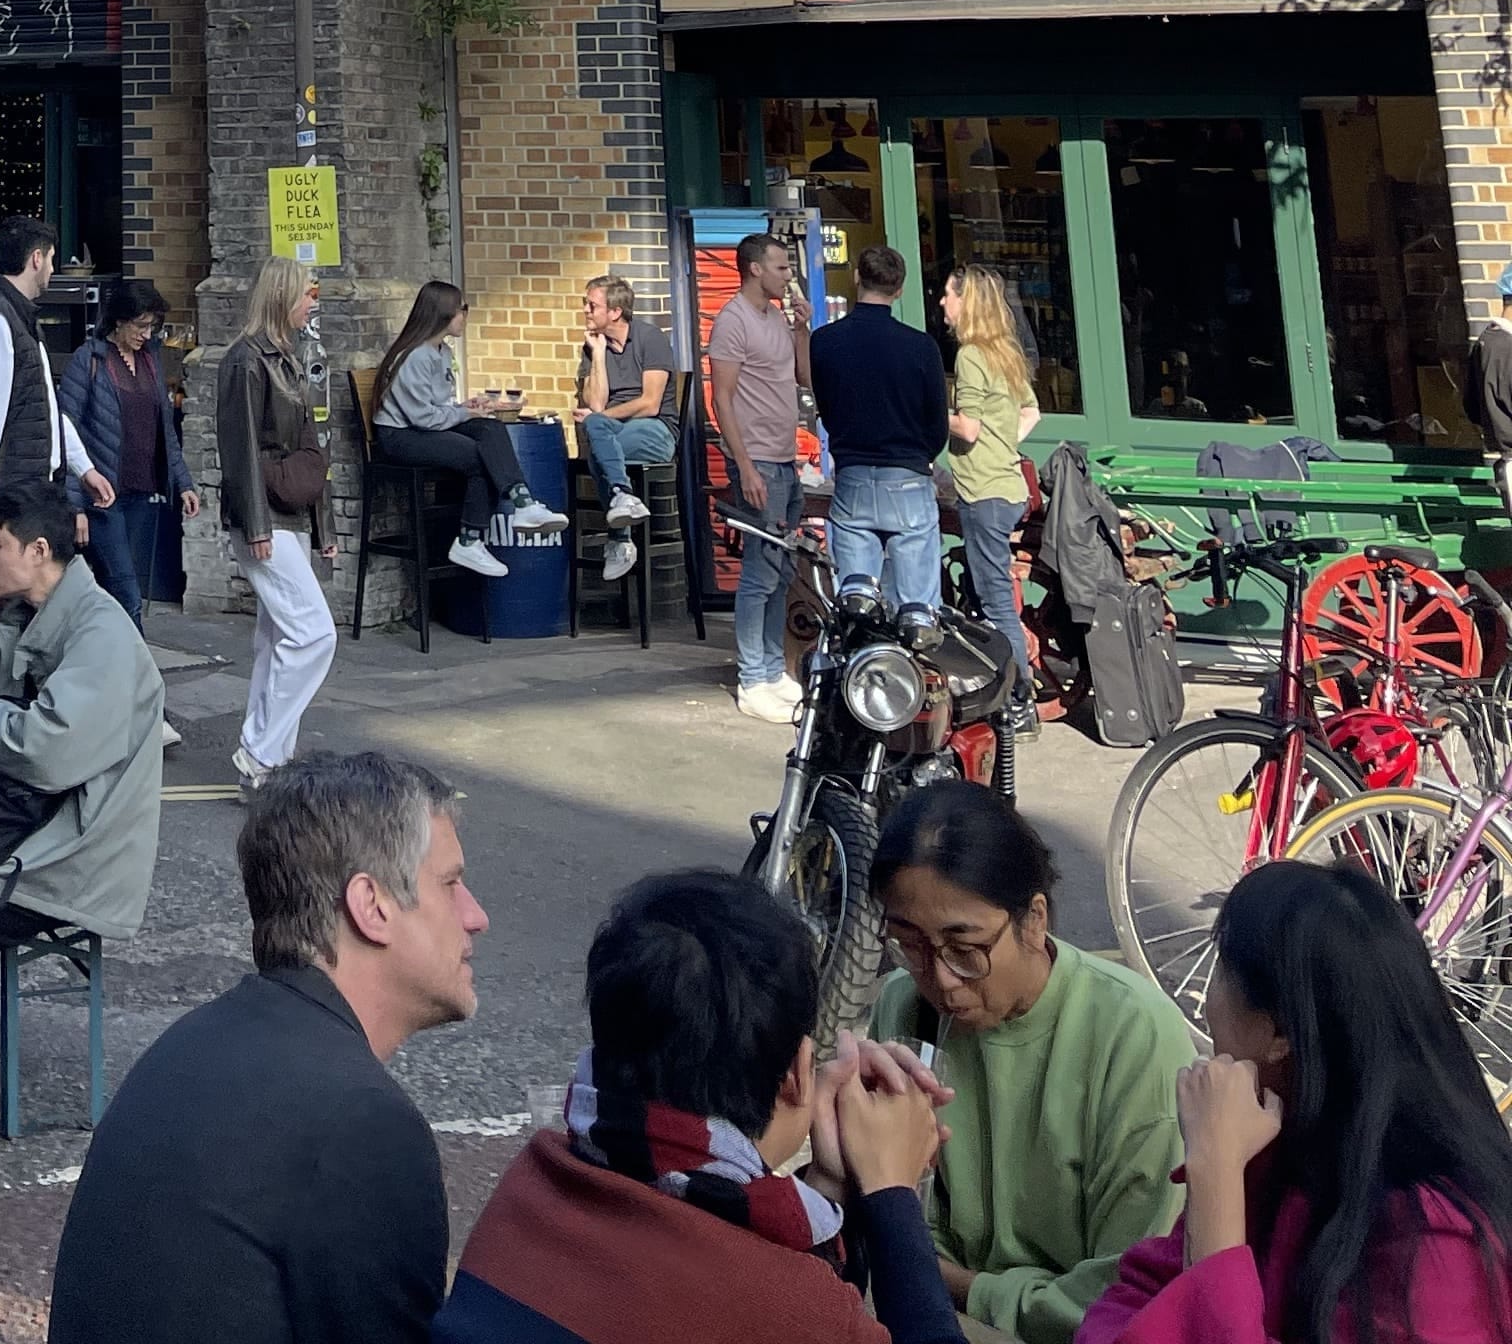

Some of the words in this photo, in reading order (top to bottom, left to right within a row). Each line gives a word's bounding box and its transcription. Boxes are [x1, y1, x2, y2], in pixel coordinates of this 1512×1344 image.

[284, 172, 319, 186] UGLY
[286, 189, 320, 202] DUCK
[287, 204, 321, 219] FLEA
[274, 223, 296, 233] THIS
[297, 221, 335, 232] SUNDAY
[306, 231, 324, 241] 3PL
